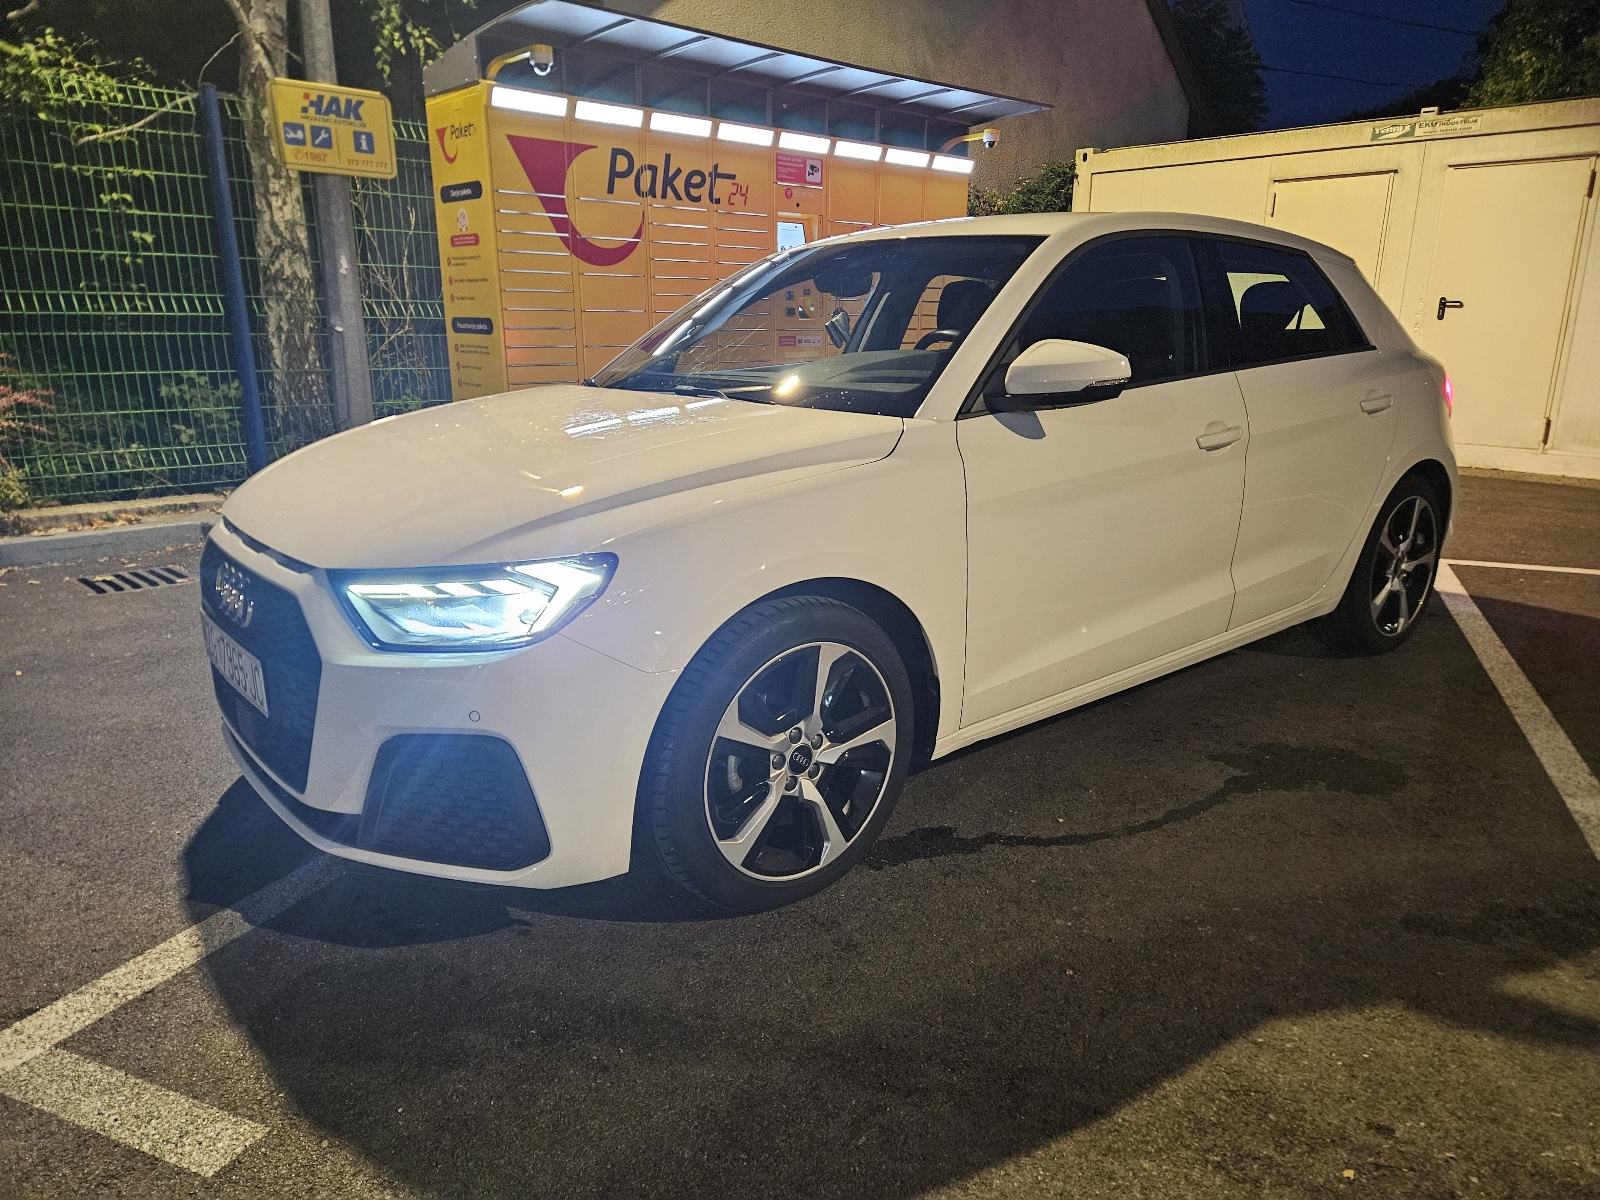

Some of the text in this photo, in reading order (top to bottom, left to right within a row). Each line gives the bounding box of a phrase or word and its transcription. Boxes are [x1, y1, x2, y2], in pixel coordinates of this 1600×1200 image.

[301, 92, 365, 121] HAK
[450, 122, 474, 141] Paket
[606, 147, 737, 205] Paket
[727, 182, 750, 207] 24
